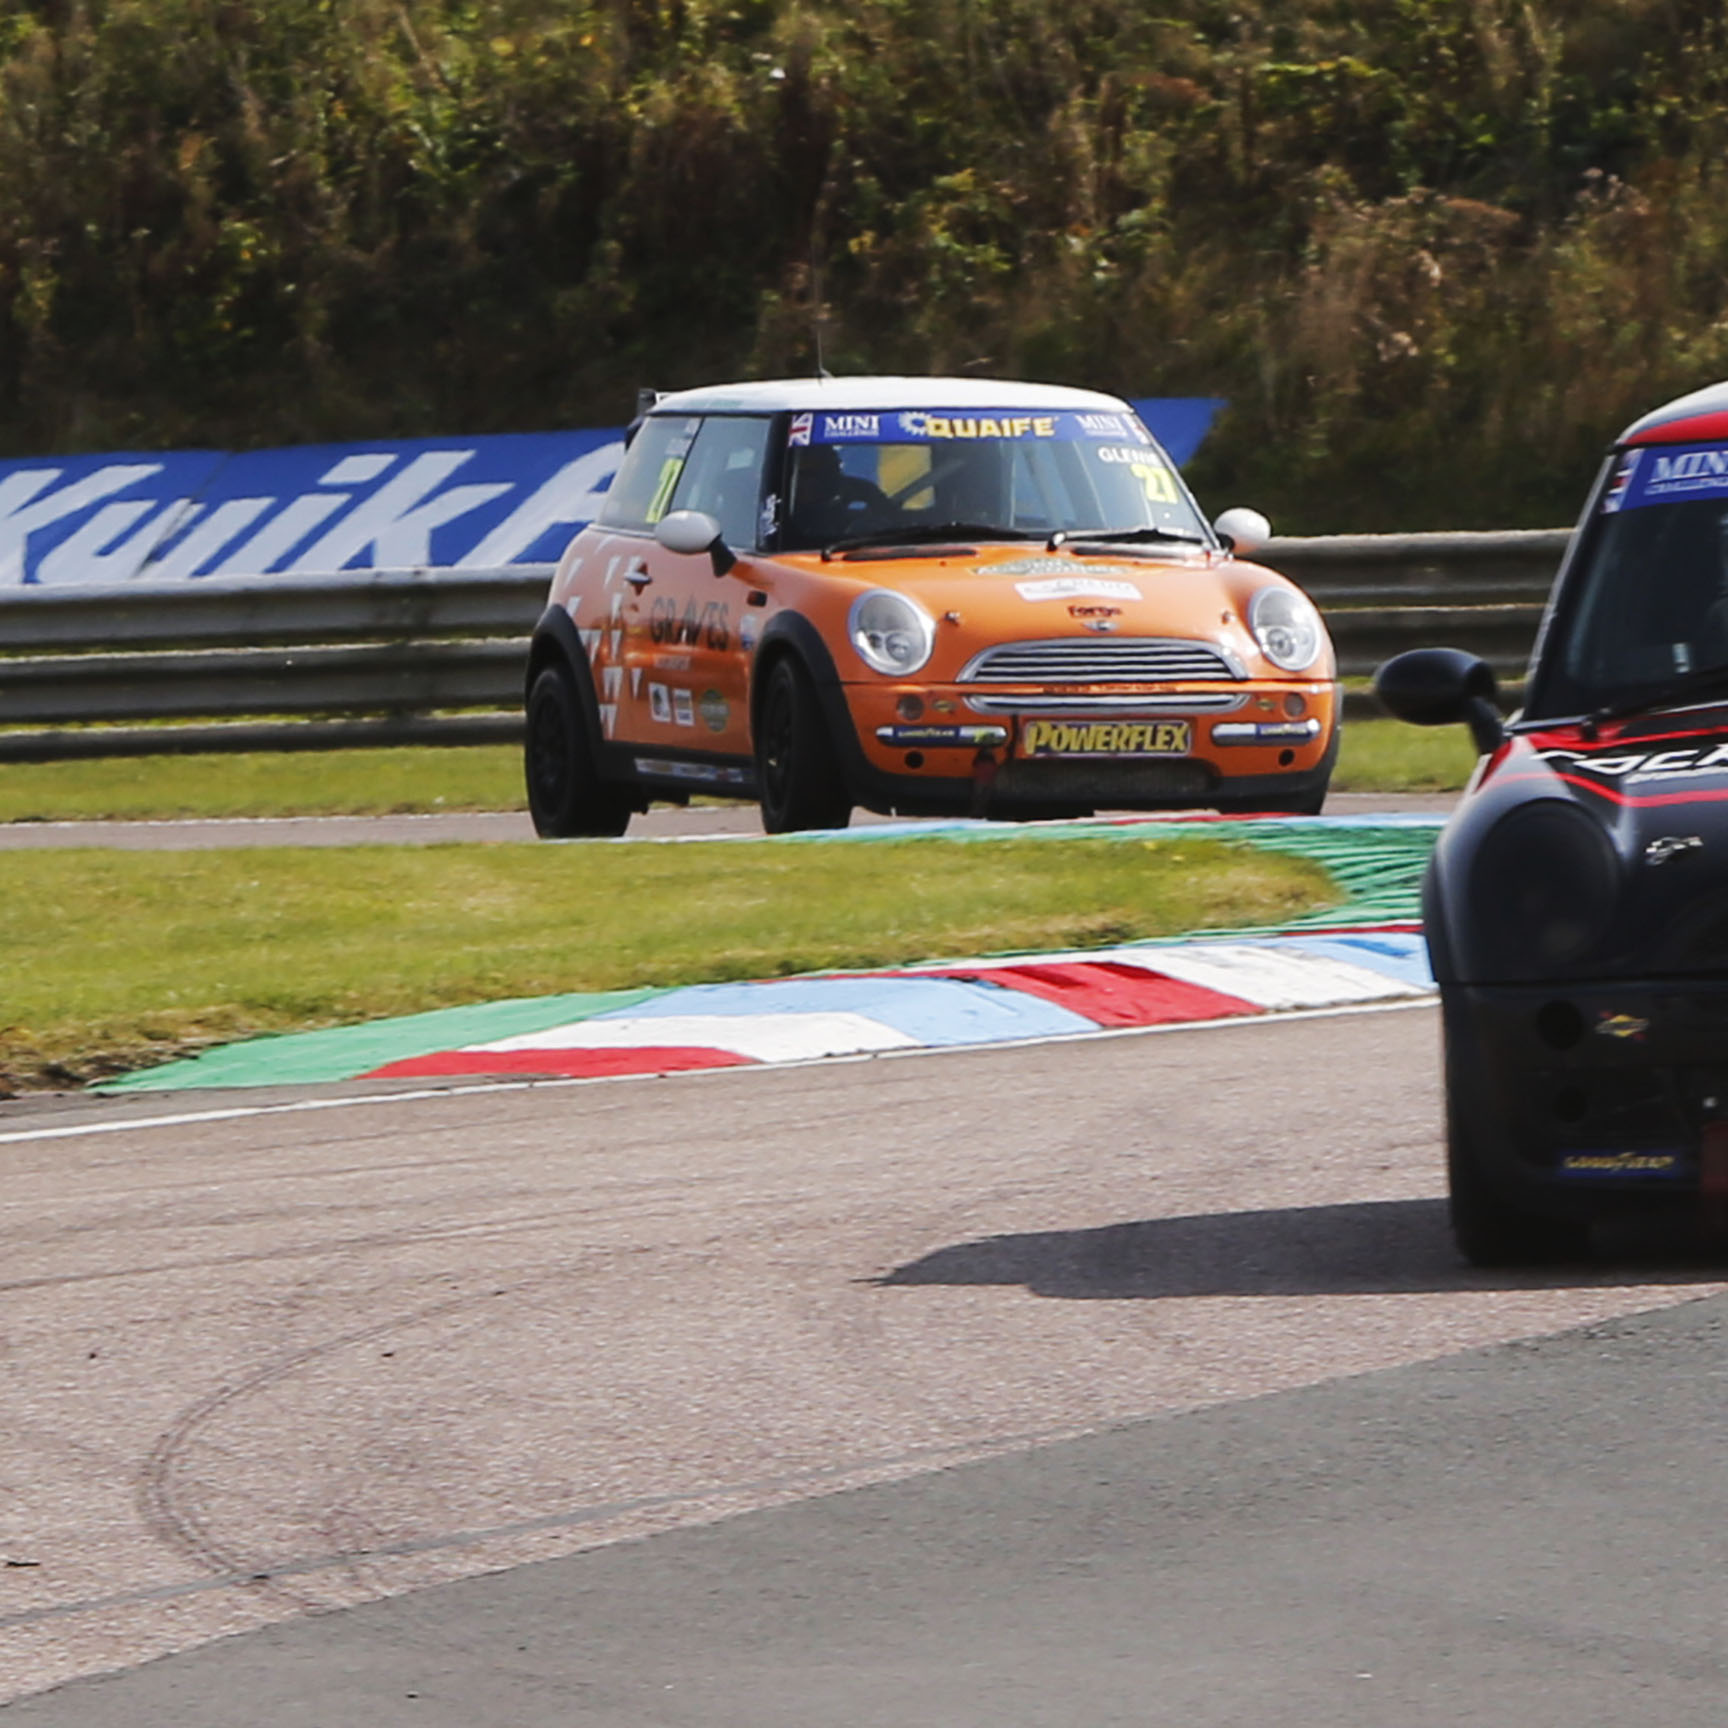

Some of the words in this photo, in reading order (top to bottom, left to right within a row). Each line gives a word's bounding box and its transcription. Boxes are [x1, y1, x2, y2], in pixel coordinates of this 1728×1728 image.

[824, 415, 880, 430] MINI
[925, 417, 1056, 439] QUAIFE
[1130, 463, 1179, 505] 27
[0, 450, 518, 584] Kwik
[1026, 722, 1189, 755] POWERFLEX
